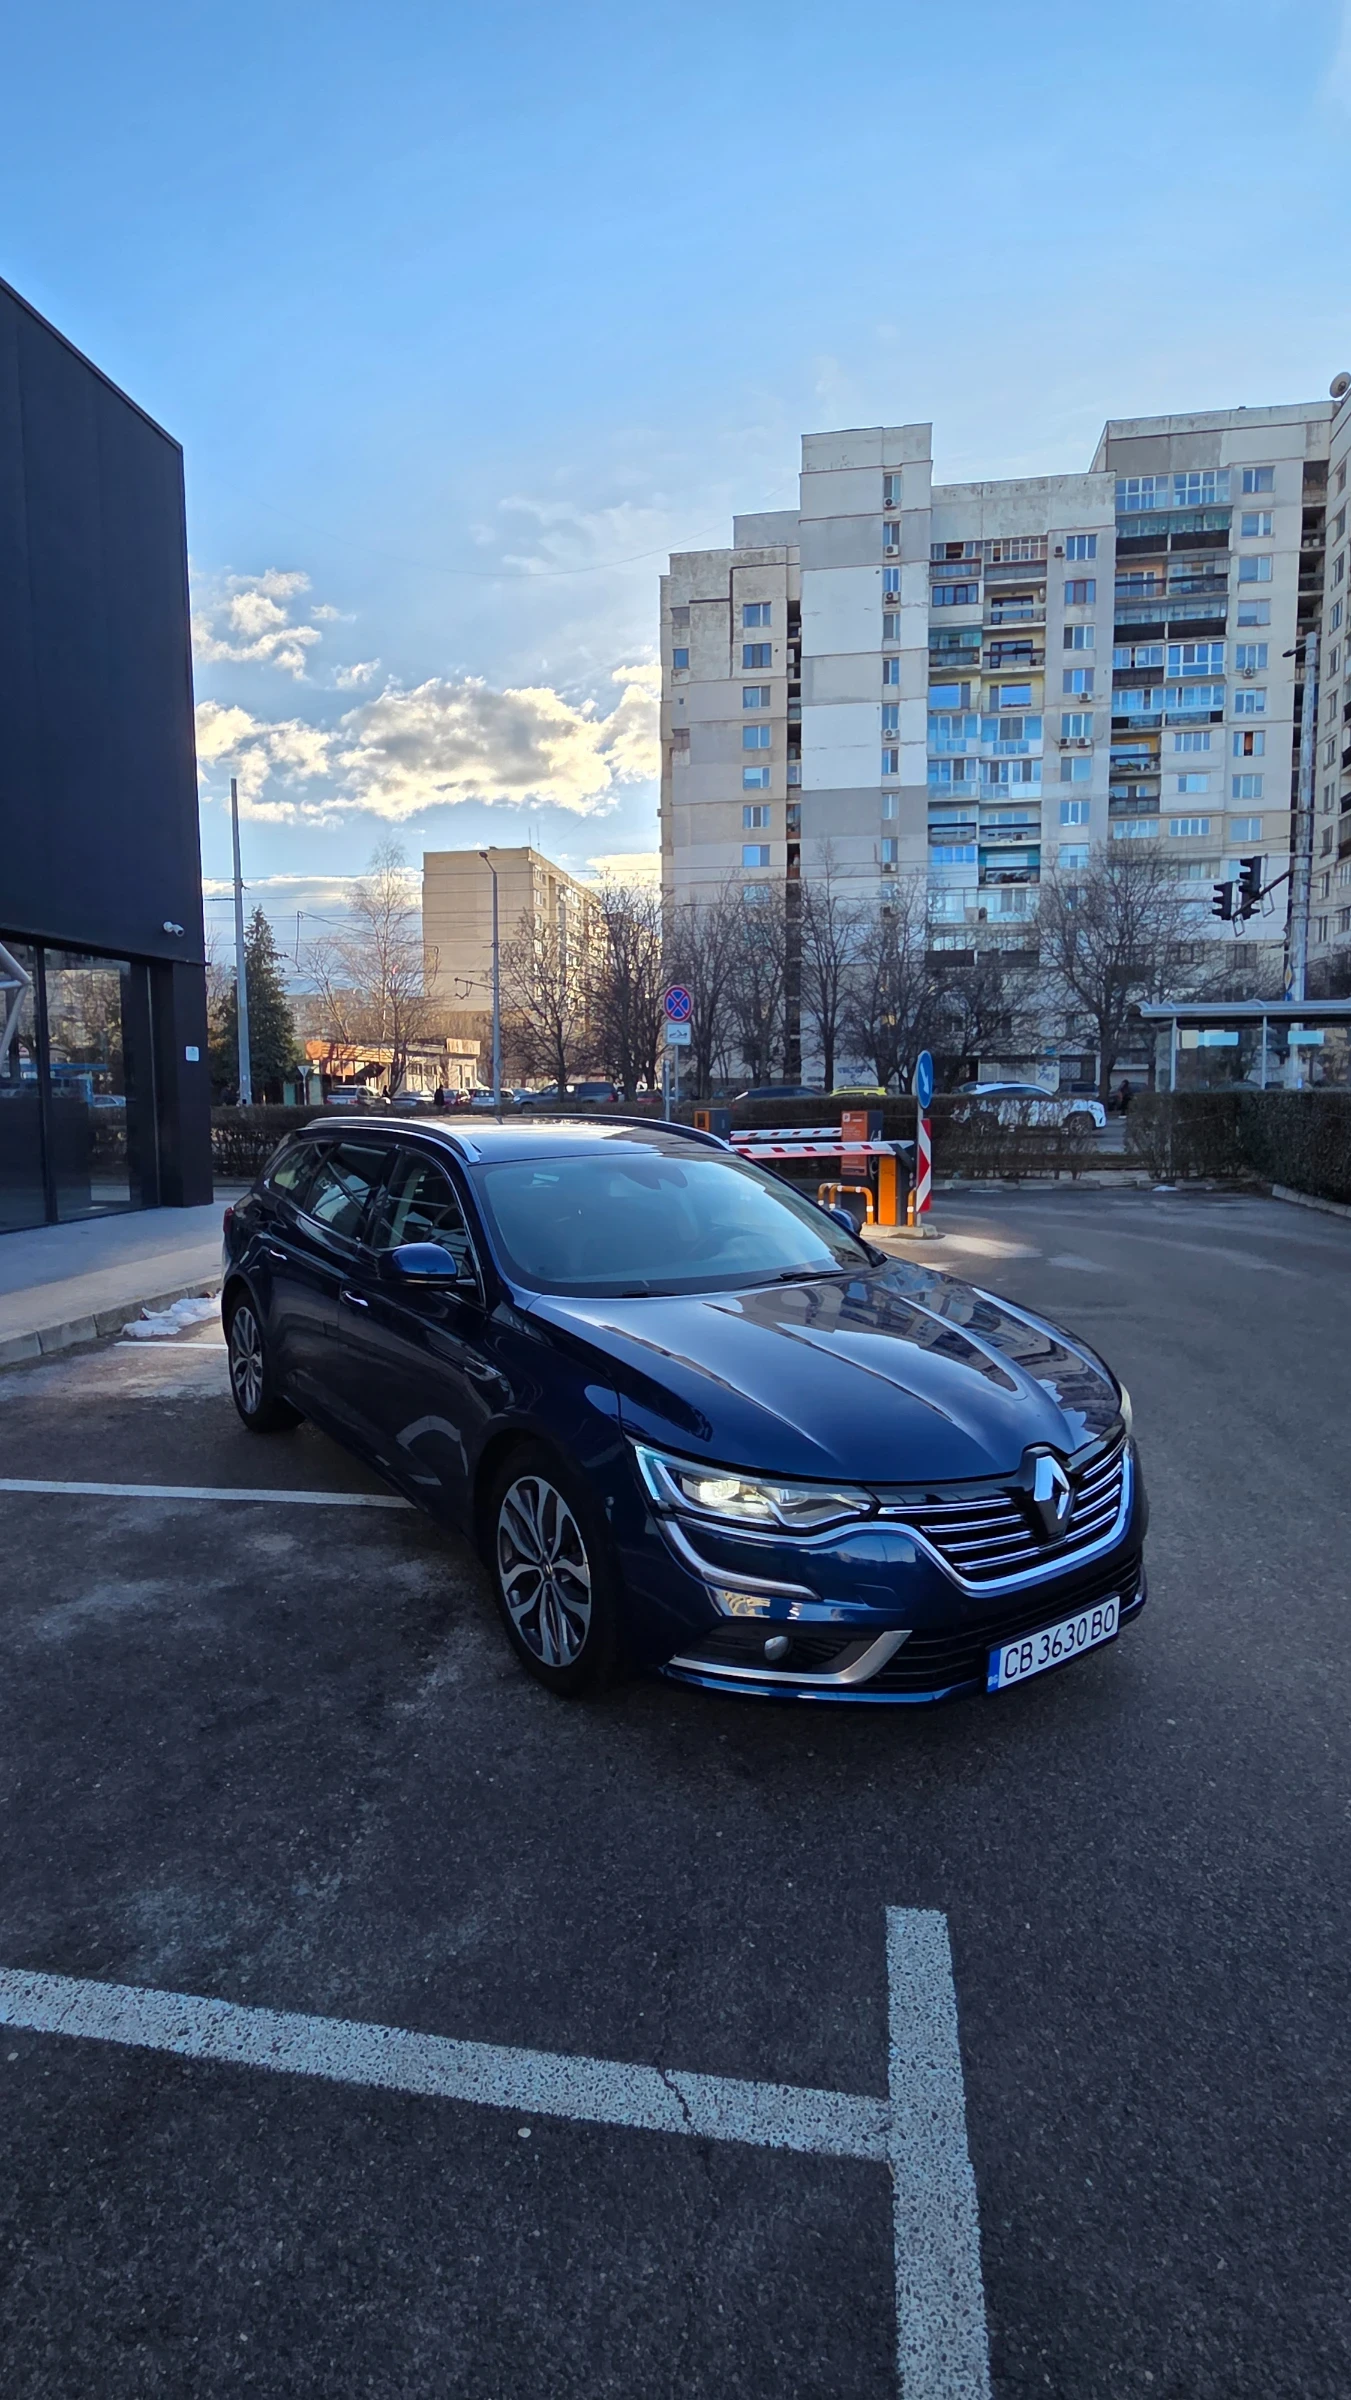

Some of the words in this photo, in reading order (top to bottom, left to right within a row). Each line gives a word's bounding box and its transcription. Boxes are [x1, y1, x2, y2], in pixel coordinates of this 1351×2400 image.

[1004, 1641, 1033, 1679] CB
[1038, 1617, 1088, 1665] 3630
[1090, 1604, 1116, 1641] BO
[987, 1674, 999, 1687] BG
